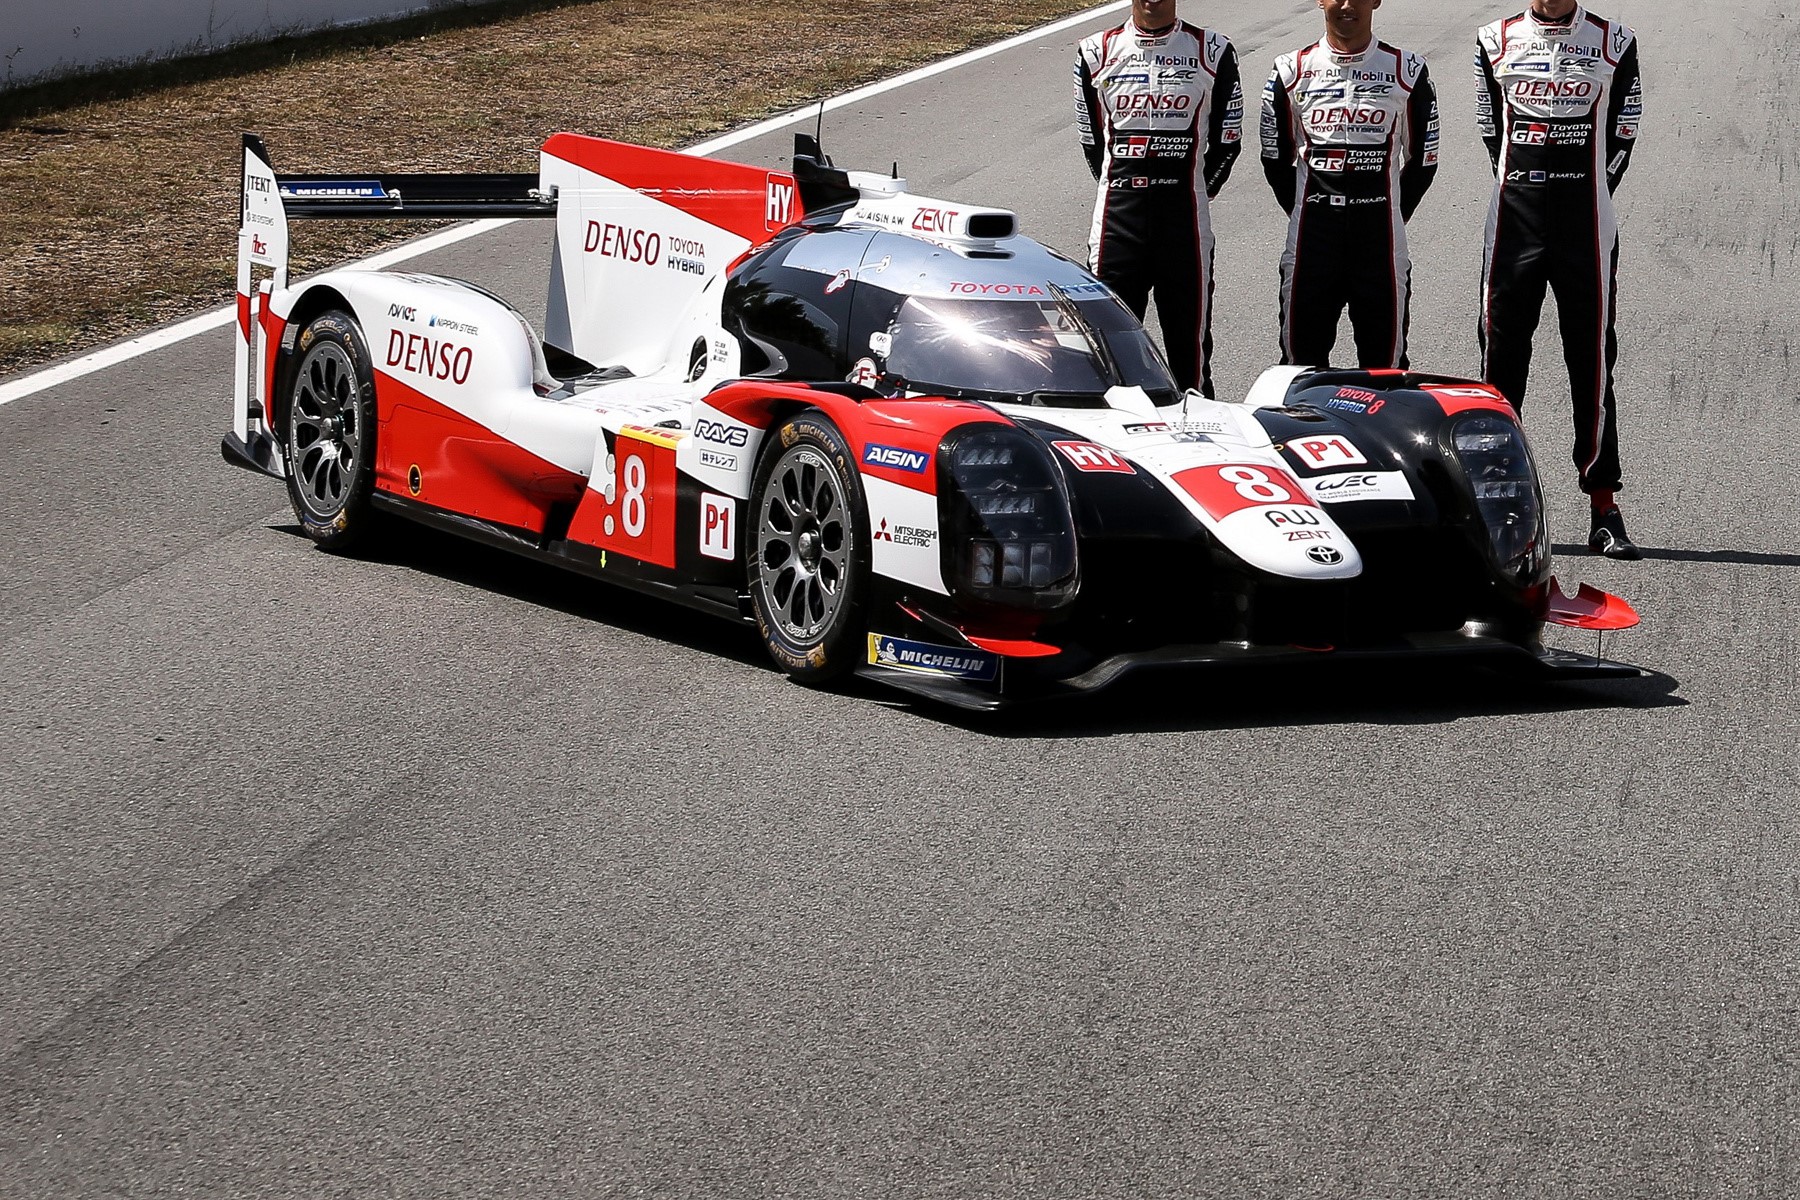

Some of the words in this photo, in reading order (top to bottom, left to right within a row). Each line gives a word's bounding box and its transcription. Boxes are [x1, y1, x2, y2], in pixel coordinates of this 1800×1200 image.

[1558, 43, 1589, 55] Mobil
[1155, 55, 1187, 66] Mobil
[1559, 58, 1599, 68] WEC
[1158, 70, 1197, 79] WEC
[1352, 70, 1383, 81] Mobil
[1354, 85, 1393, 94] WEC
[1515, 80, 1592, 97] DENSO
[1116, 95, 1191, 110] DENSO
[1516, 97, 1548, 106] TOYOTA
[1311, 108, 1386, 124] DENSO
[1512, 131, 1545, 143] GR
[1113, 144, 1146, 157] GR
[1311, 159, 1342, 169] GR
[247, 175, 271, 193] JTEKT
[767, 182, 793, 224] HY
[867, 211, 889, 223] AISIN
[891, 215, 904, 225] AW
[912, 208, 958, 233] ZENT
[584, 220, 661, 266] DENSO
[668, 236, 705, 258] TOYOTA
[667, 255, 705, 275] HYBRID
[950, 282, 1044, 295] TOYOTA
[436, 318, 459, 331] NIPPON
[459, 323, 479, 335] STEEL
[386, 329, 473, 385] DENSO
[1336, 387, 1376, 402] TOYOTA
[1326, 399, 1366, 413] HYBRID
[1367, 400, 1386, 415] 8
[694, 418, 748, 448] RAYS
[800, 424, 837, 453] MICHELIN
[866, 446, 925, 471] AISIN
[1069, 445, 1121, 468] HY
[1301, 439, 1354, 462] P1
[1218, 466, 1291, 503] 8
[1315, 475, 1378, 490] WEC
[622, 454, 646, 538] 8
[705, 503, 729, 550] P1
[894, 525, 937, 540] MITSUBISHI
[894, 534, 931, 548] ELECTRIC
[1283, 531, 1333, 542] ZENT
[900, 651, 985, 671] MICHELIN
